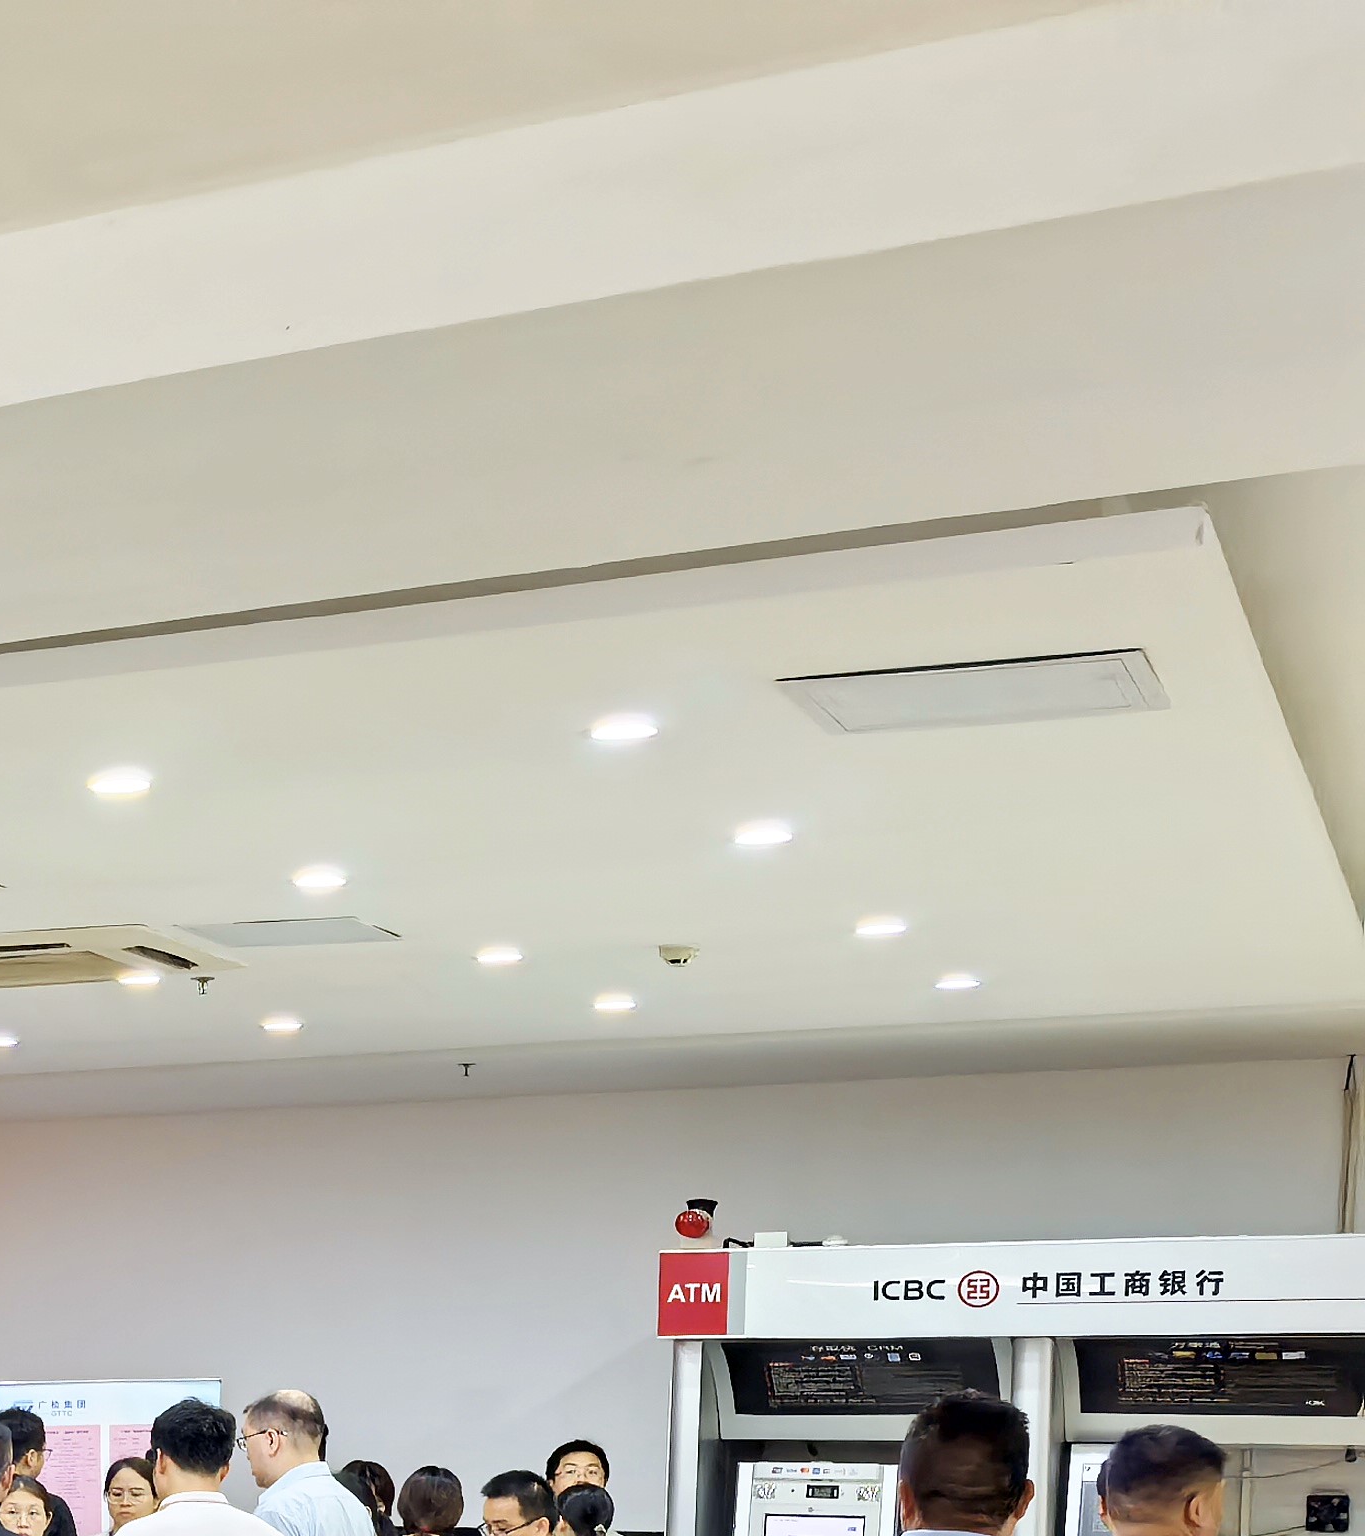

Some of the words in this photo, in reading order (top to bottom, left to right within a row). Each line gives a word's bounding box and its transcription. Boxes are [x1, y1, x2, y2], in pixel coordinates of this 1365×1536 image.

[667, 1282, 722, 1304] ATM
[872, 1279, 946, 1302] ICBC
[1020, 1268, 1226, 1300] 中国工商银行
